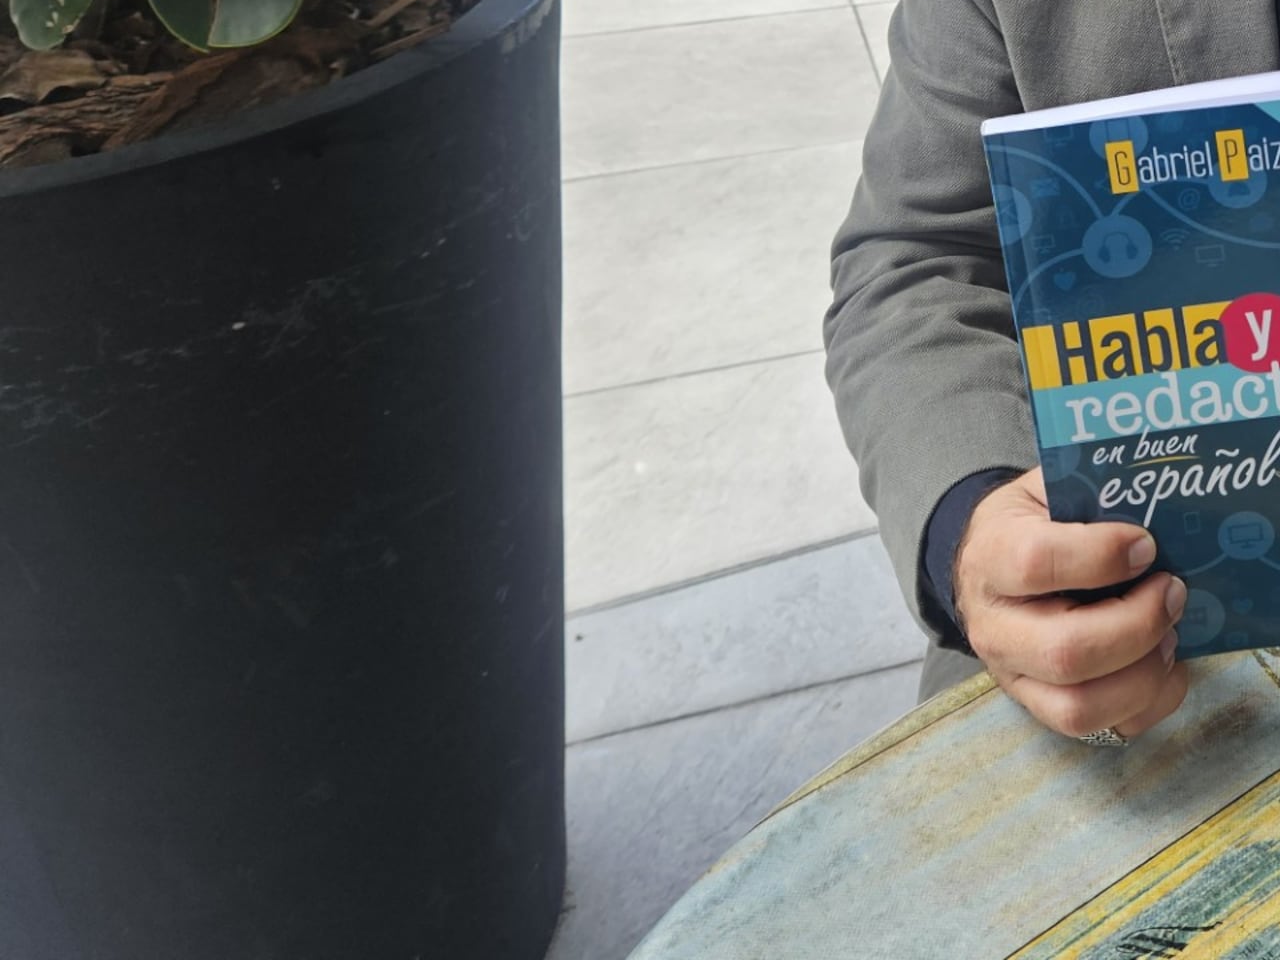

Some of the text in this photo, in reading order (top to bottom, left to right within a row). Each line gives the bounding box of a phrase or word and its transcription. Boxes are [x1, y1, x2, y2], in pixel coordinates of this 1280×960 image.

[1111, 141, 1214, 187] Gabriel
[1053, 307, 1273, 386] Habla y
[1092, 425, 1200, 465] en buen
